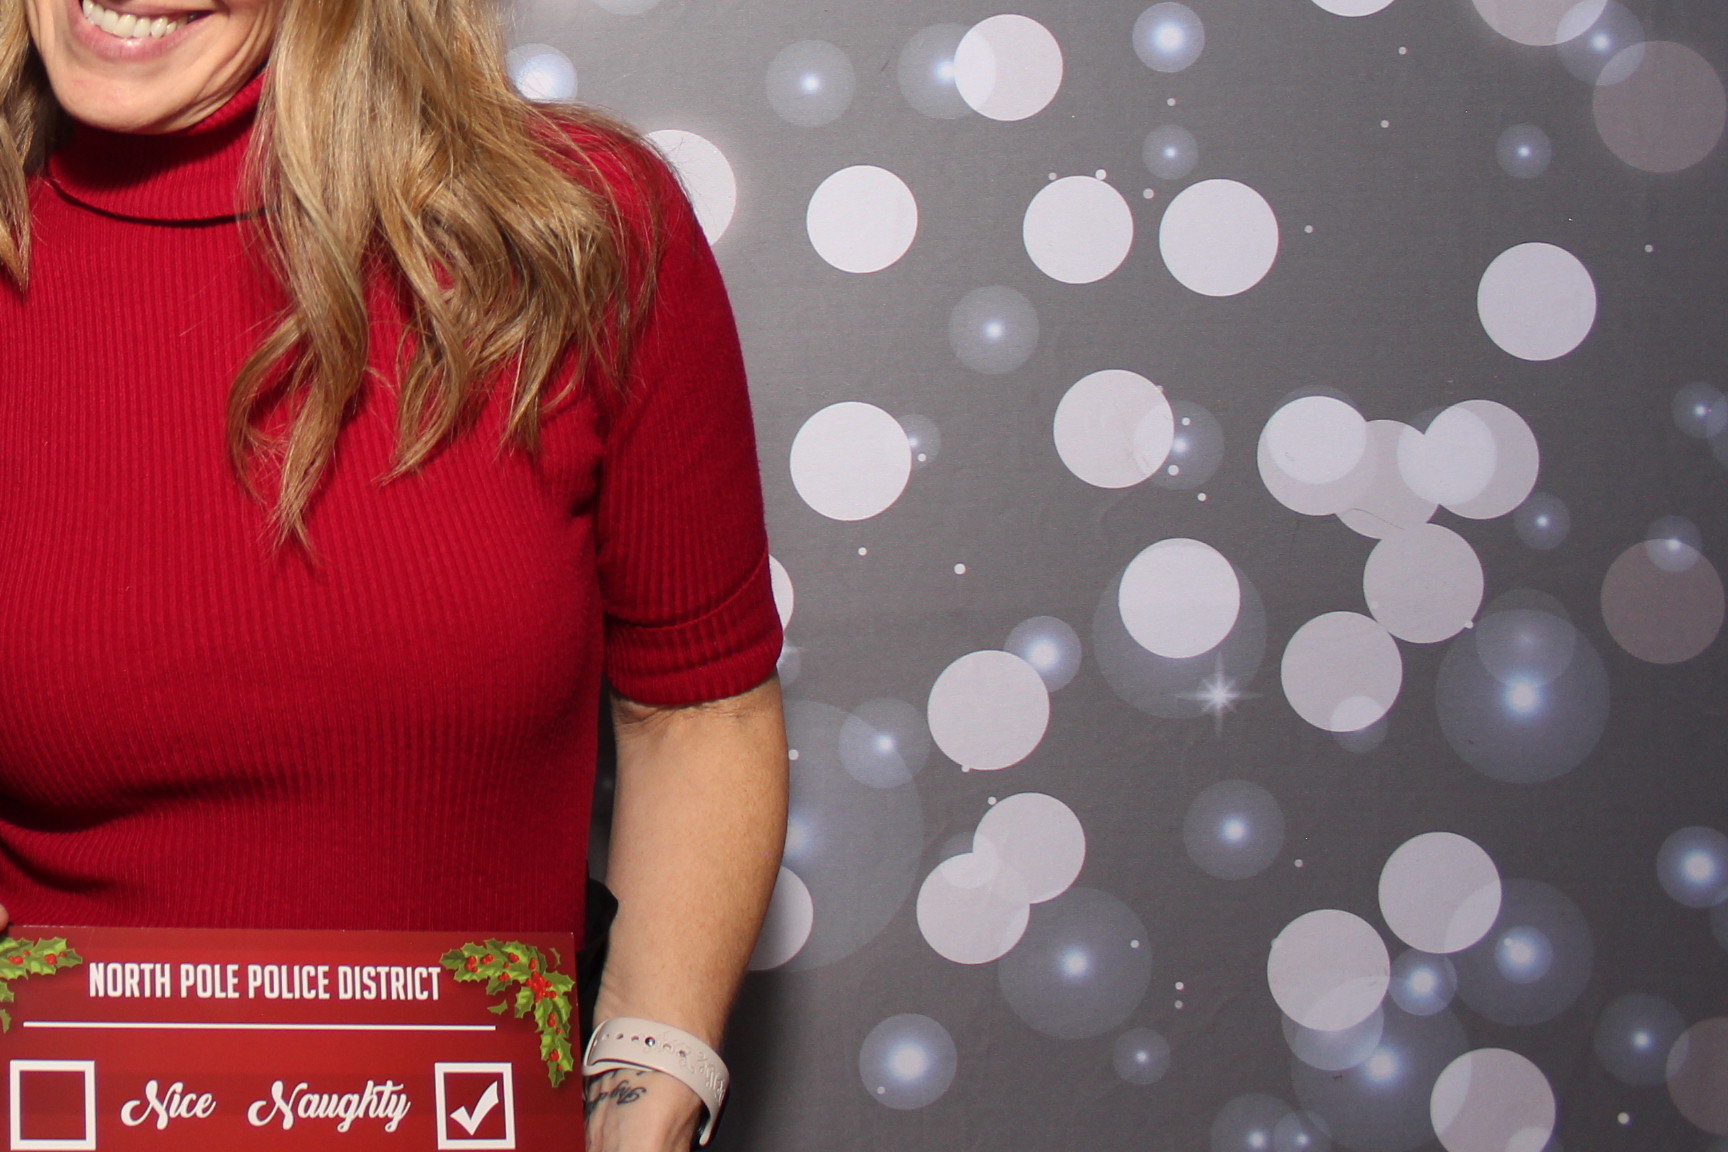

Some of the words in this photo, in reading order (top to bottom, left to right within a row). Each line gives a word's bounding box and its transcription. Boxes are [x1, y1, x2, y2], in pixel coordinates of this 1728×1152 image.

[89, 962, 171, 999] NORTH
[180, 963, 240, 1000] POLE
[247, 964, 330, 1001] POLICE
[337, 965, 441, 1001] DISTRICT
[120, 1080, 217, 1130] Nice
[247, 1080, 411, 1133] Naughty
